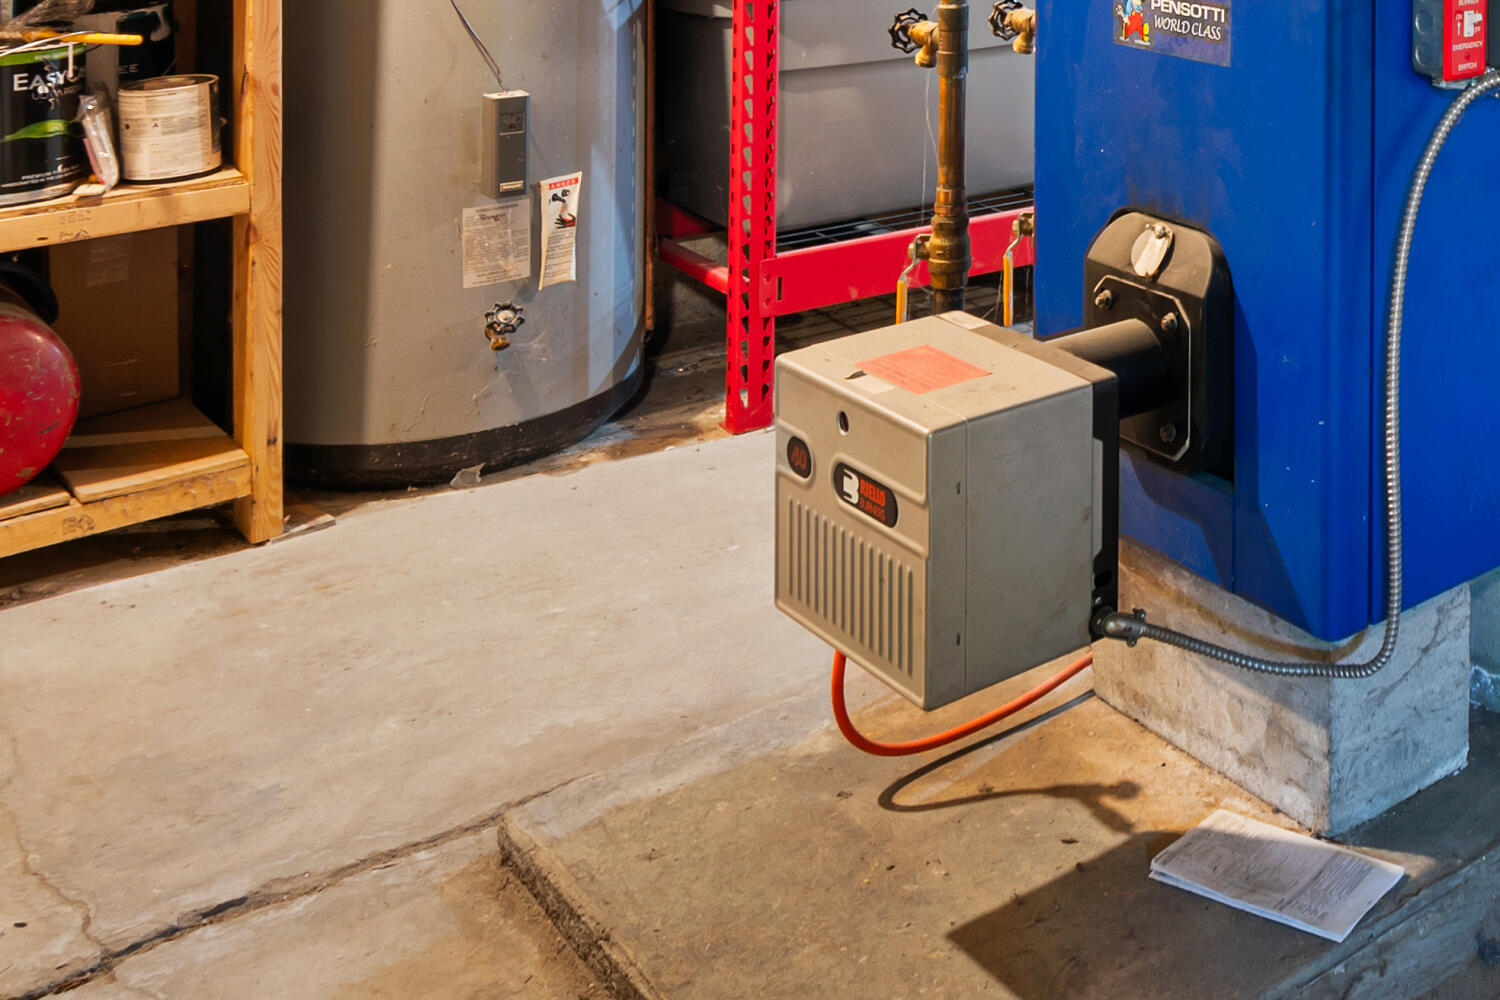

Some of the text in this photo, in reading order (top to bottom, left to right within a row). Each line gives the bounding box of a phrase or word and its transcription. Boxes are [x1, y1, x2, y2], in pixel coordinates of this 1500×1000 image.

[1154, 14, 1222, 41] WORLD CLASS
[1452, 41, 1483, 51] EMERGENCY
[1458, 62, 1477, 71] SWITCH
[547, 178, 579, 190] ANGER
[792, 446, 807, 470] 40
[860, 480, 886, 507] RIELLO
